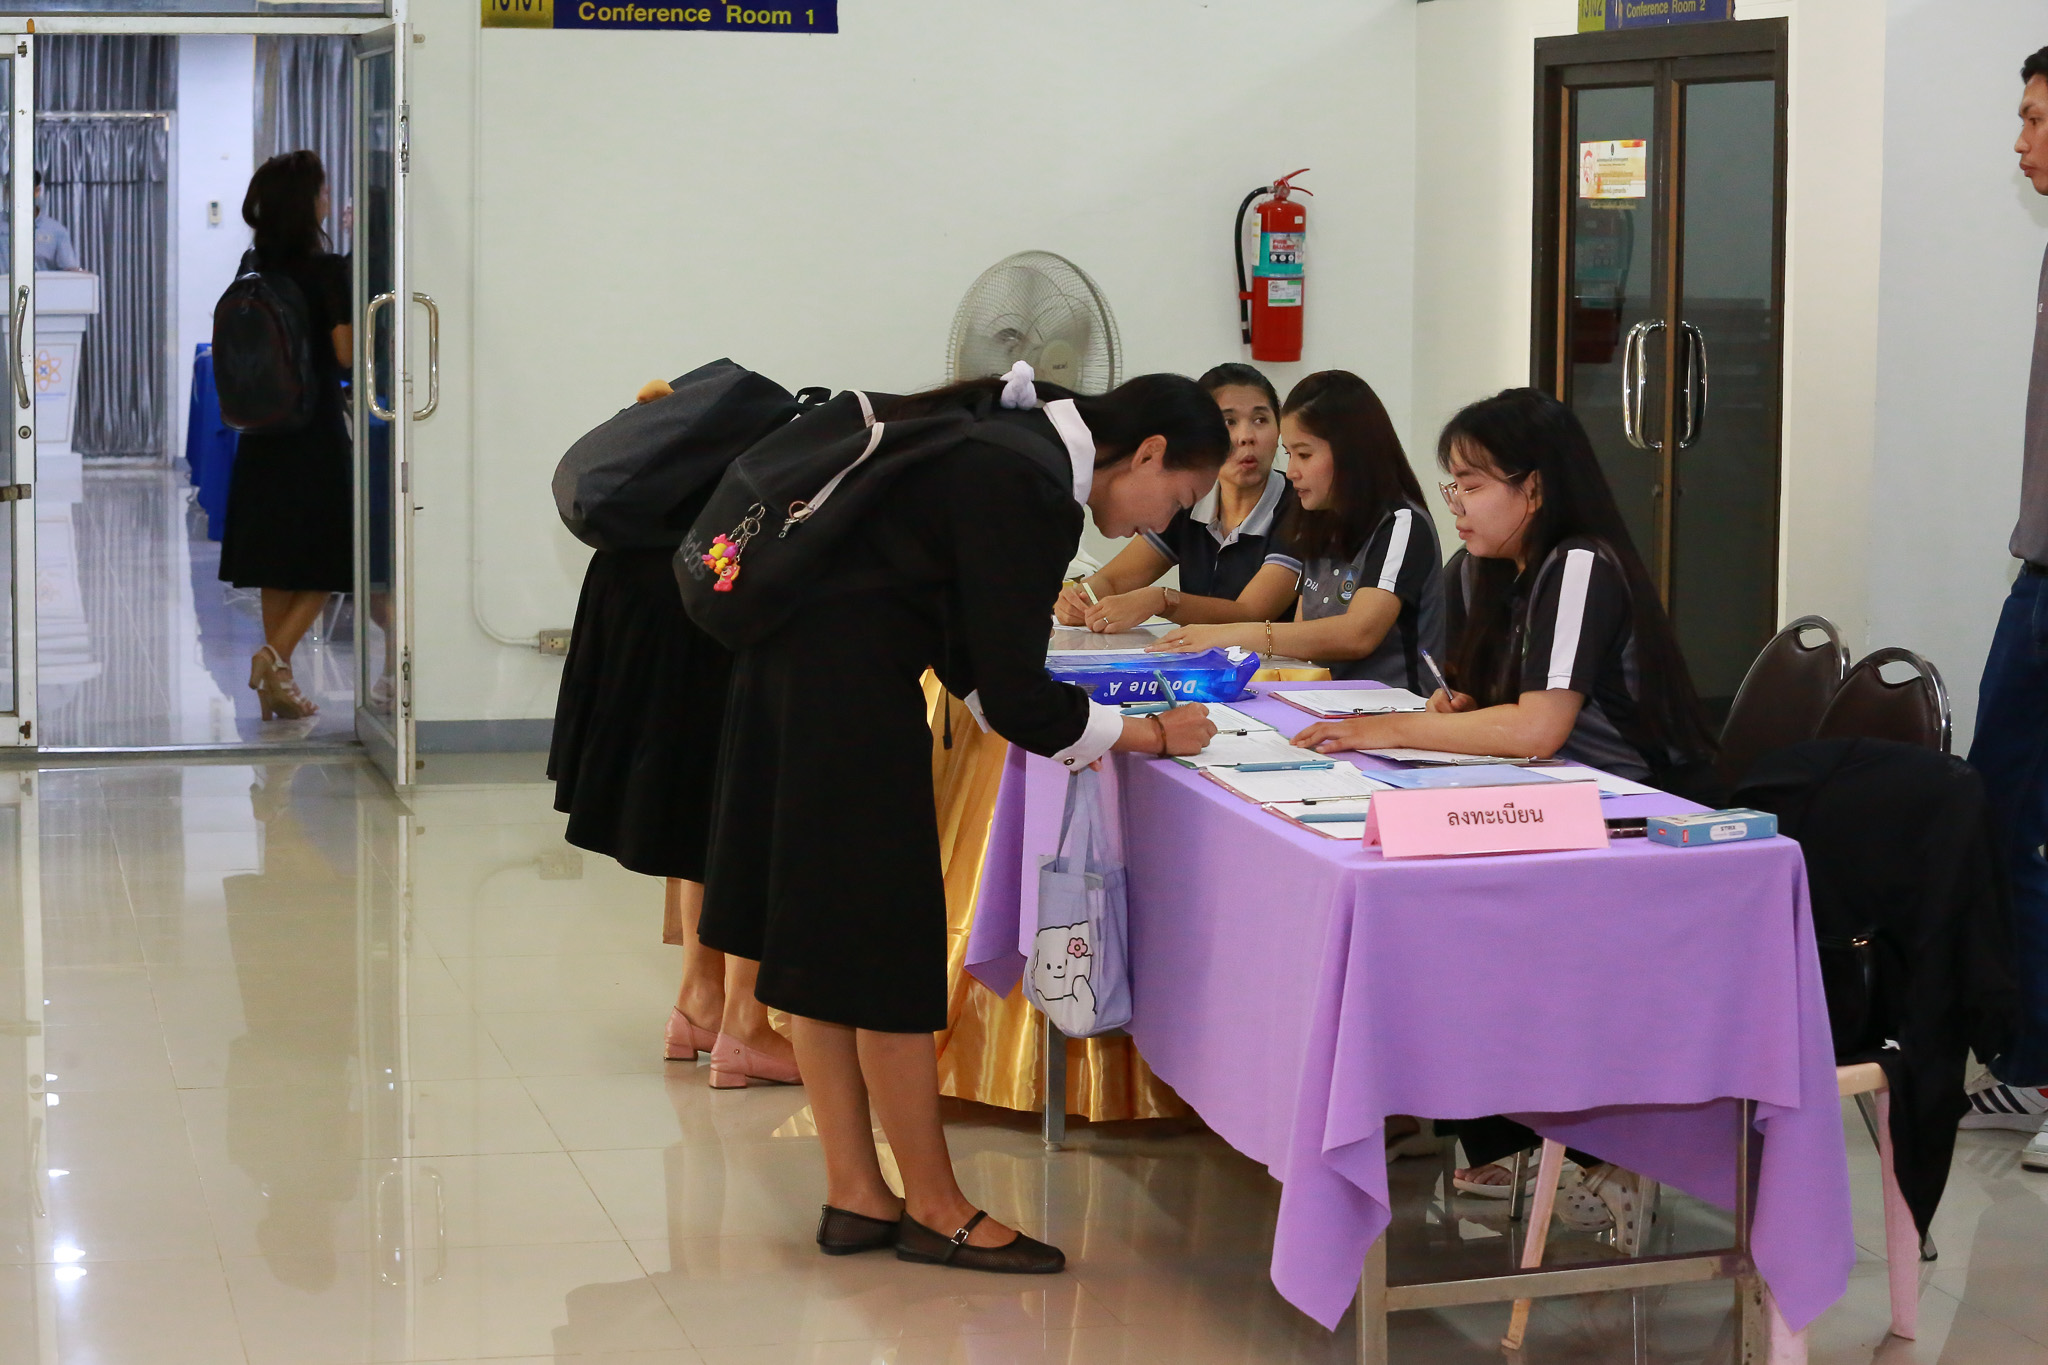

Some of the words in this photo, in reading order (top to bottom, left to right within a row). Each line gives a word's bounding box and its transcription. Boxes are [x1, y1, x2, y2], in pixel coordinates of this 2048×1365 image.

[578, 1, 712, 23] Conference
[726, 6, 792, 25] Room
[805, 8, 814, 25] 1
[1626, 1, 1670, 18] Conference
[1671, 0, 1697, 13] Room
[1129, 679, 1197, 695] Doble
[1446, 802, 1544, 826] ลงทะเบียน
